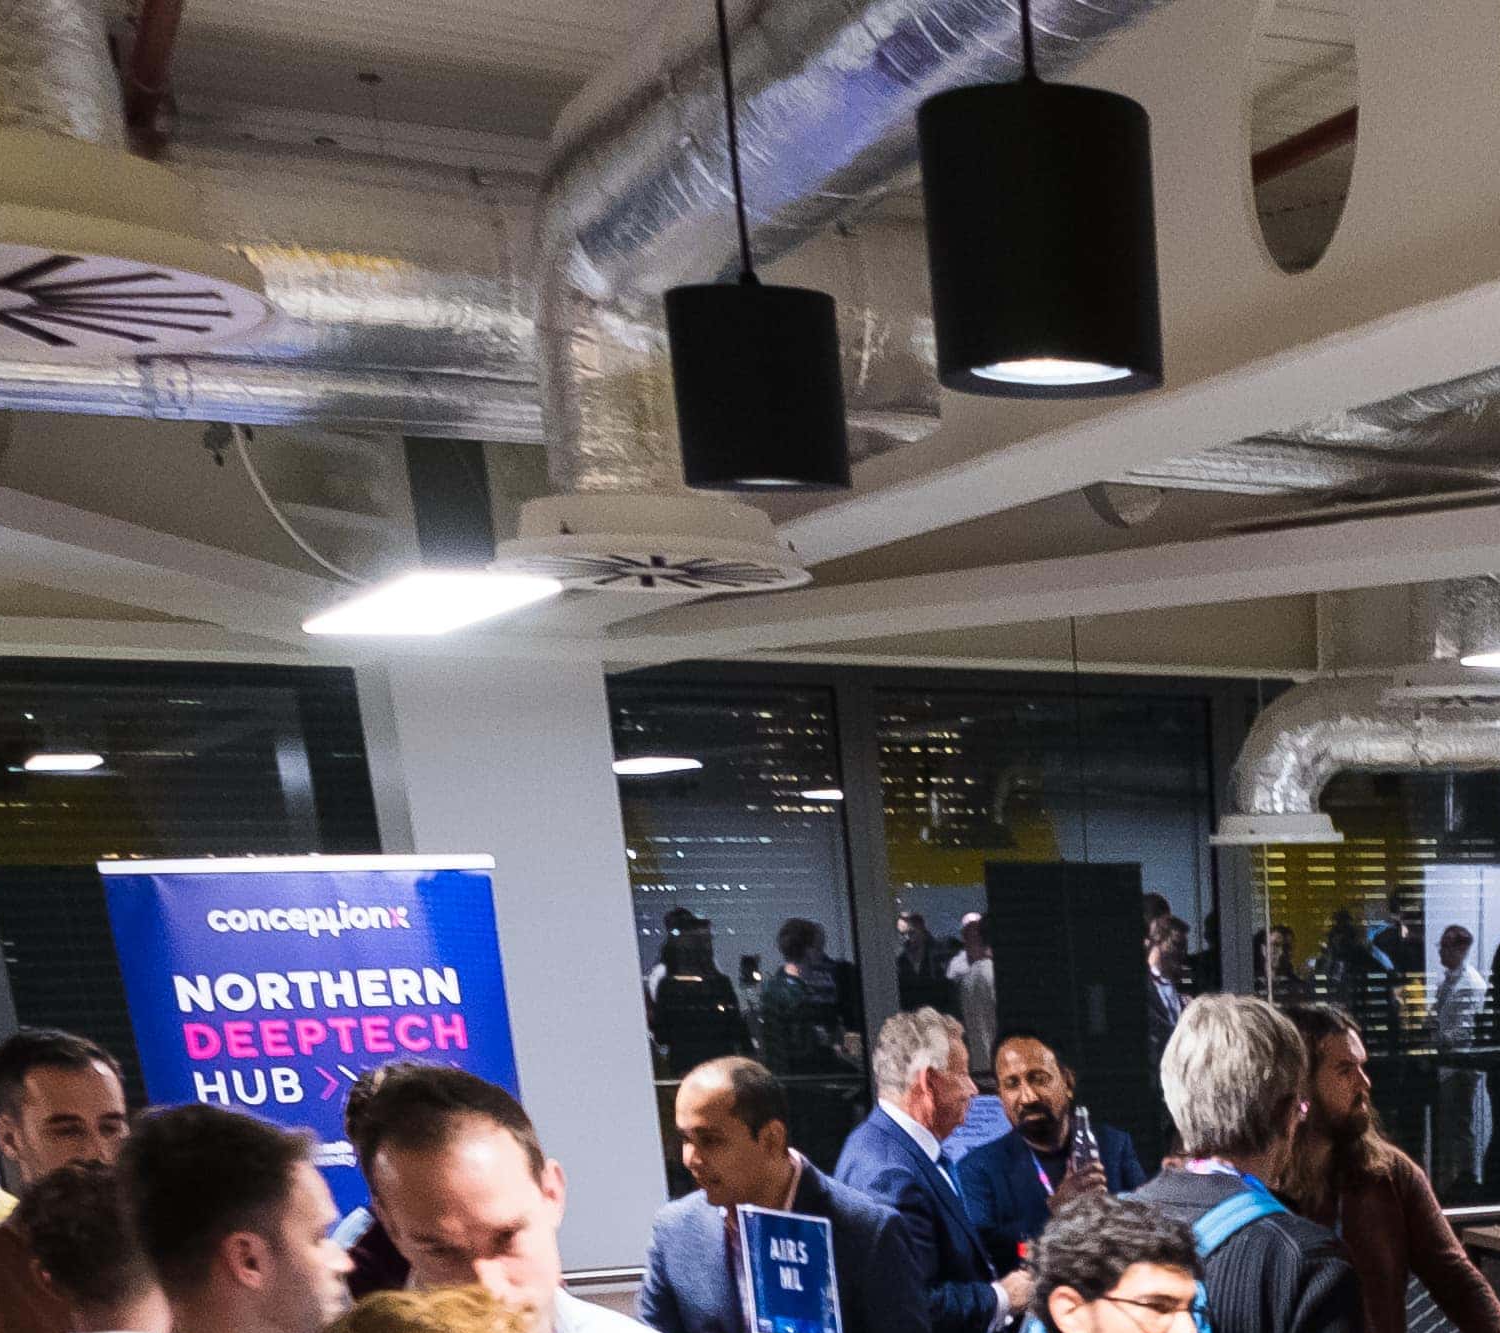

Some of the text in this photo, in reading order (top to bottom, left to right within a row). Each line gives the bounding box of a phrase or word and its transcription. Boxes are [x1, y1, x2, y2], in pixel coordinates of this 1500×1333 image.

[173, 967, 461, 1013] NORTHERN
[183, 1014, 468, 1060] DEEPTECH
[192, 1067, 304, 1106] HUB
